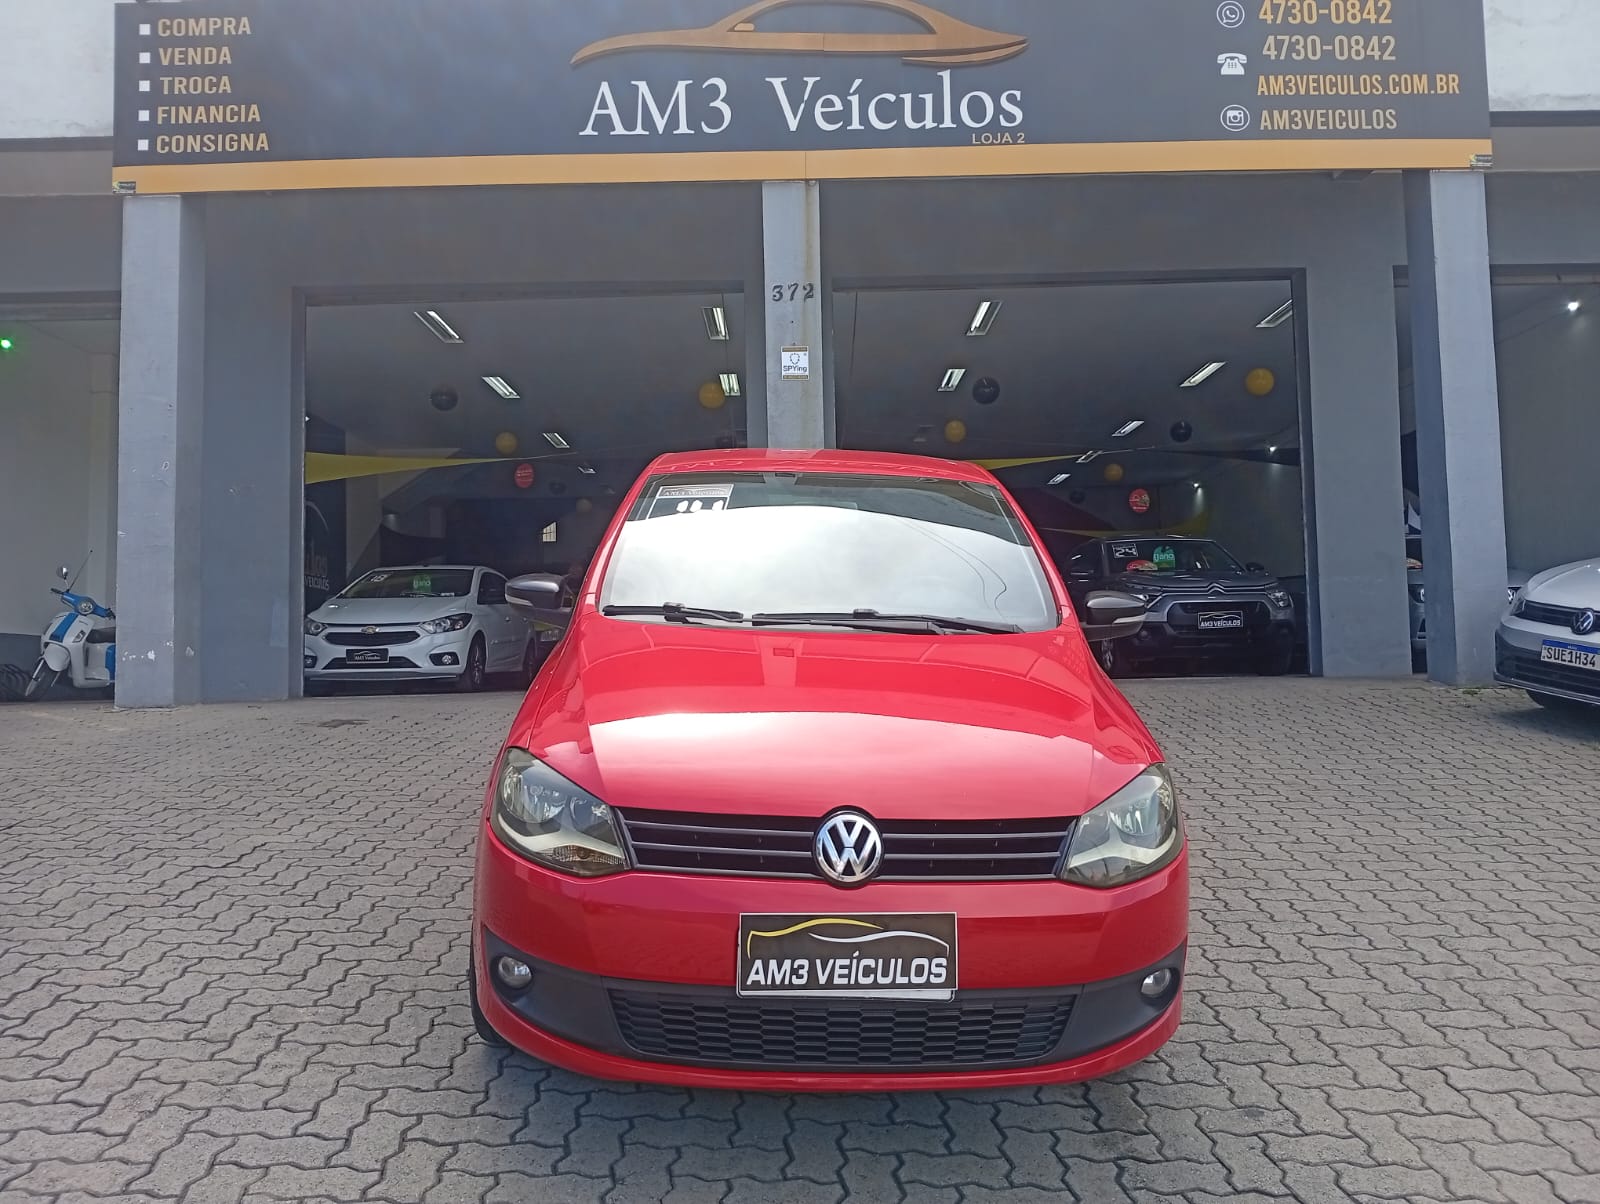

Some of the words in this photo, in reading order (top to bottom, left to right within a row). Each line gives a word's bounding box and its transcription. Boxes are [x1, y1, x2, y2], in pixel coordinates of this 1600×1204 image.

[1258, 0, 1392, 25] 4730-0842
[157, 16, 251, 37] COMPRA
[158, 46, 232, 66] VENDA
[1262, 34, 1396, 61] 4730-0842
[159, 75, 232, 95] TROCA
[1257, 73, 1460, 96] AM3VEICULOS.COM.BR
[579, 76, 732, 136] AM3
[765, 69, 1024, 133] Veículos
[157, 103, 261, 125] FINANCIA
[1259, 108, 1398, 131] AM3VEICULOS
[156, 132, 270, 154] CONSIGNA
[972, 132, 1013, 145] LOJA
[1016, 132, 1026, 143] 2
[772, 282, 815, 303] 372
[783, 365, 808, 373] SPYing
[1546, 647, 1596, 668] SUE1H34
[746, 957, 809, 985] AM3
[816, 950, 947, 984] VEÍCULOS
